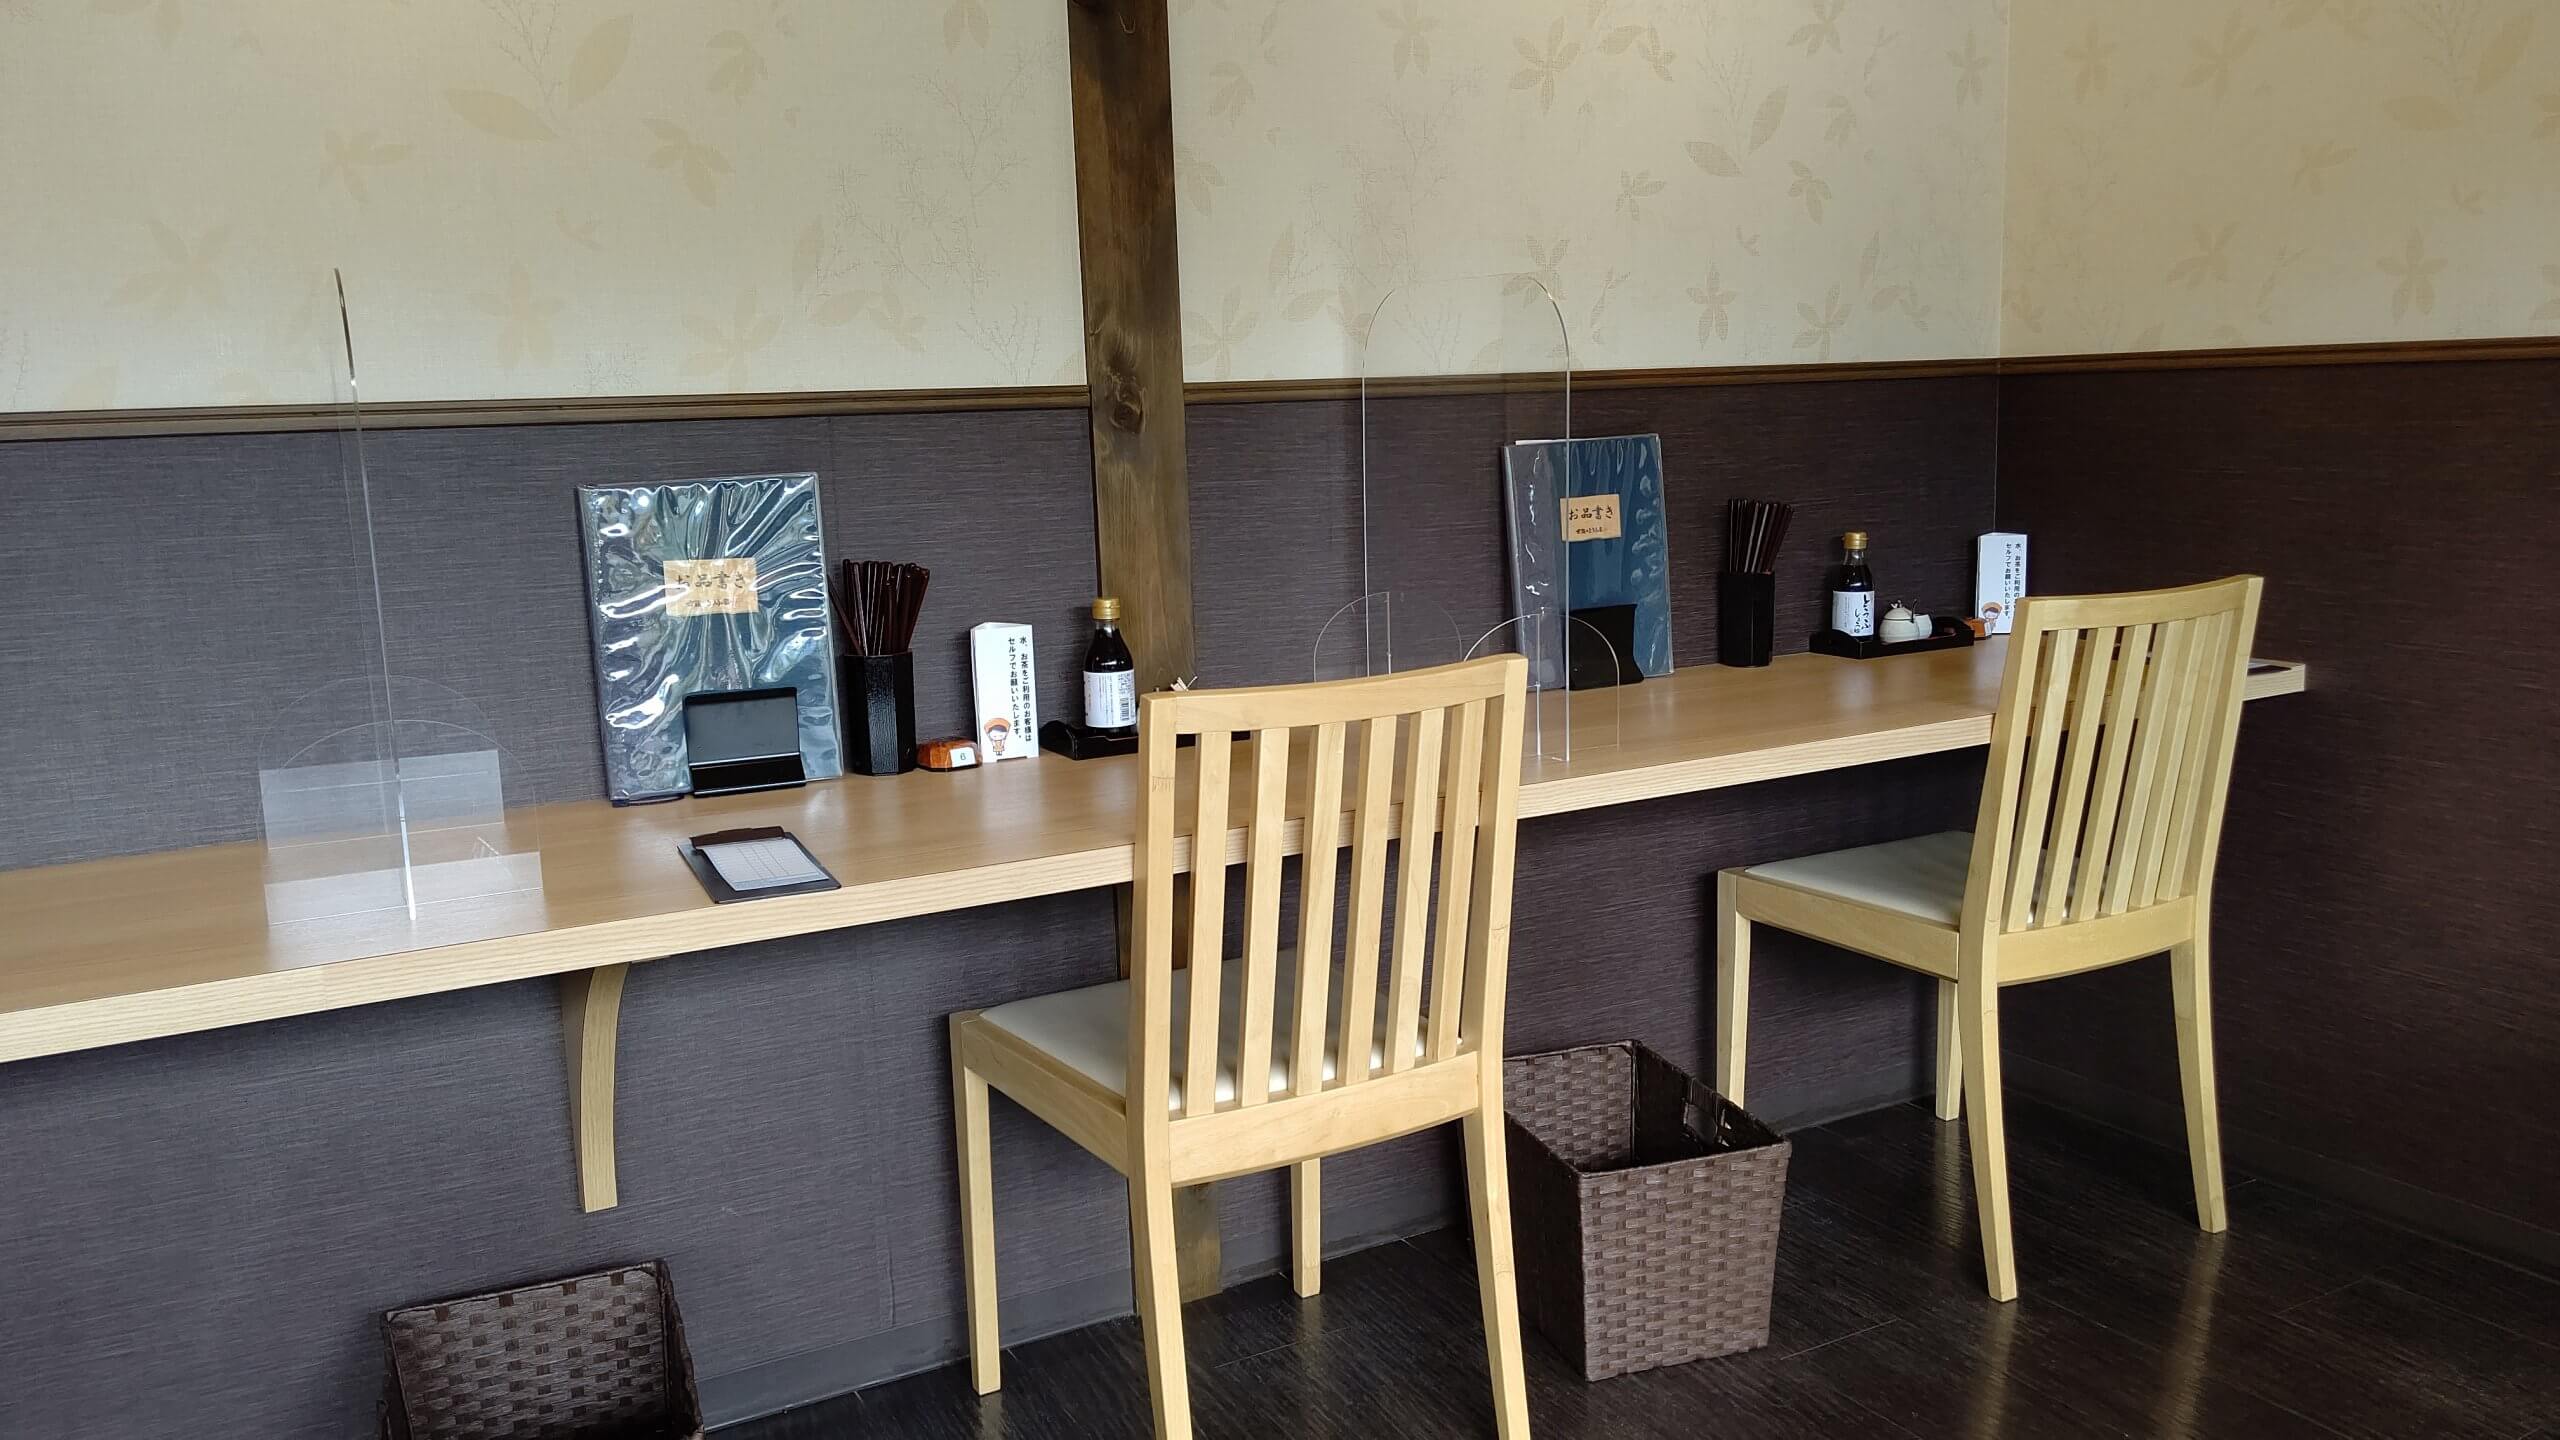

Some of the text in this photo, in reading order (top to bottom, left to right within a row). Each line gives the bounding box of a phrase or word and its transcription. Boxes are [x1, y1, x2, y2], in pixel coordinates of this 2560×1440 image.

[1569, 505, 1613, 521] お品書き
[2013, 543, 2021, 608] 水、お茶をご利用の
[1008, 637, 1022, 739] セルフでお願いいたします。
[1019, 636, 1032, 742] 水、お茶をご利用のお客様は
